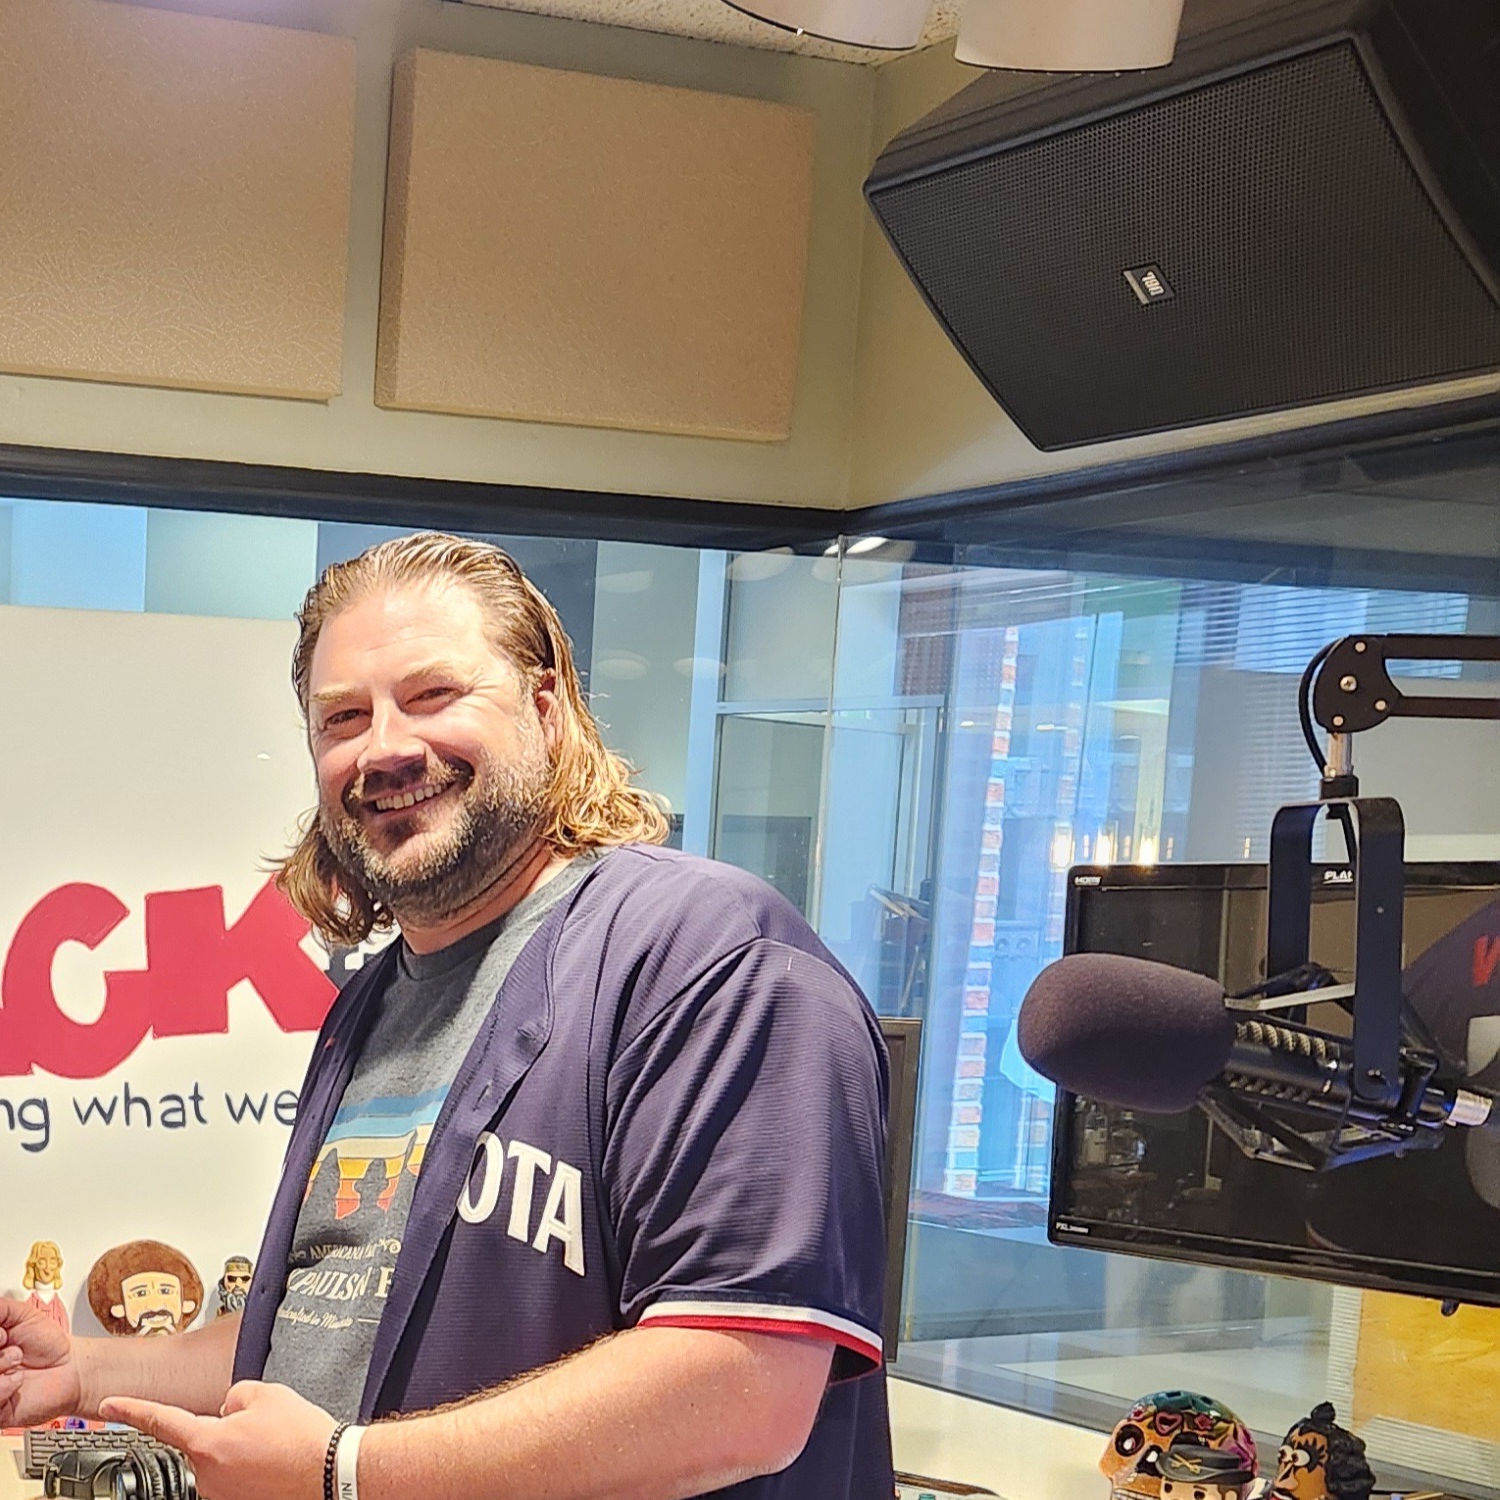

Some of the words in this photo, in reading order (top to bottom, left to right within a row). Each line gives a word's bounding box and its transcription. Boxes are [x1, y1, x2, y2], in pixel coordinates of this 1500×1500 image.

[1141, 271, 1165, 297] JBL
[74, 1080, 207, 1130] what
[226, 1089, 300, 1127] we
